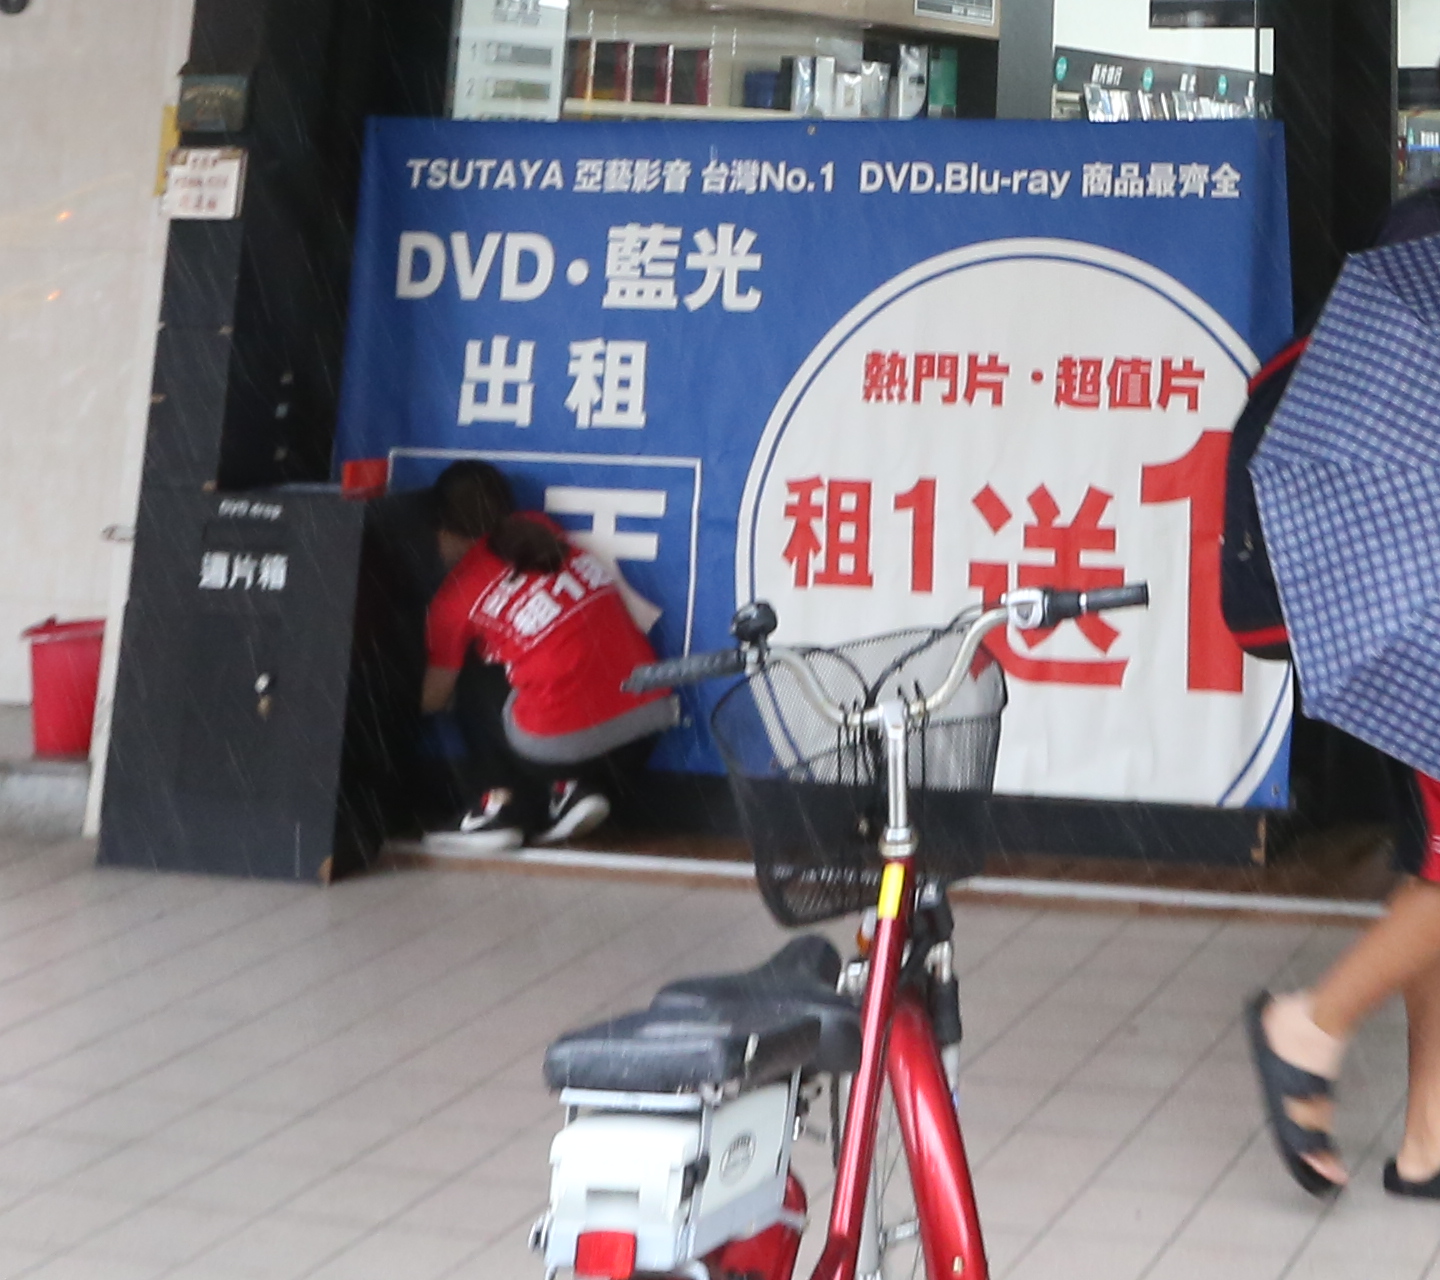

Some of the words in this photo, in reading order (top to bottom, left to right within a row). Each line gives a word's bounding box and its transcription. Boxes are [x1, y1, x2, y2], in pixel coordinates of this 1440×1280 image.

[406, 159, 564, 190] TSUTAYA
[572, 159, 692, 193] 亞藝影音
[701, 158, 836, 194] 台灣No.1
[860, 161, 1071, 198] DVD.Blu-ray
[1082, 162, 1241, 198] 商品最齊全
[457, 336, 648, 429] 出租
